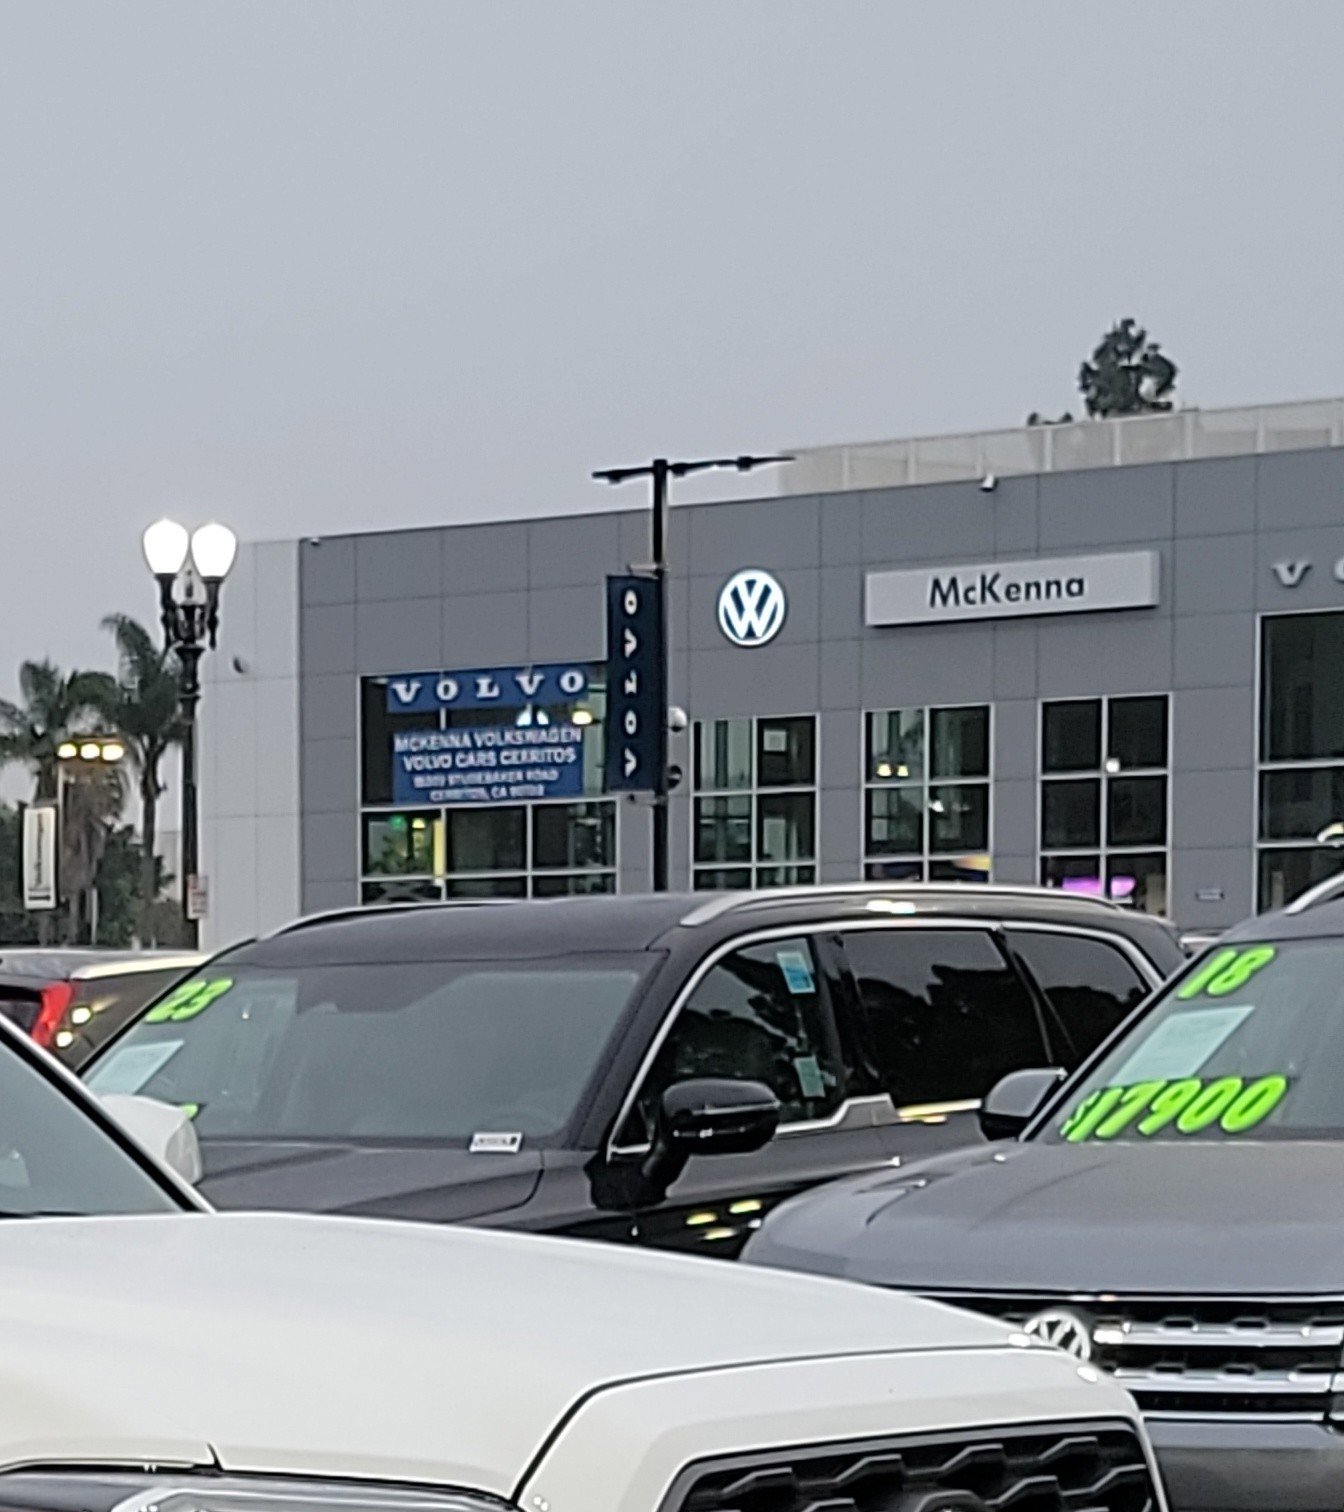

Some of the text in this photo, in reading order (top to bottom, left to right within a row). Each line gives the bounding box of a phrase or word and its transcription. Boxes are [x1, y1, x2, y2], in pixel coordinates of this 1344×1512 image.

[929, 572, 1084, 608] McKenna
[391, 670, 585, 704] VOLVO
[624, 589, 638, 779] VOLVO
[472, 727, 582, 749] VOLKSWAGEN
[403, 753, 453, 772] VOLVO
[455, 750, 497, 769] CARS
[1177, 943, 1276, 999] 18
[1059, 1073, 1288, 1142] $17900
